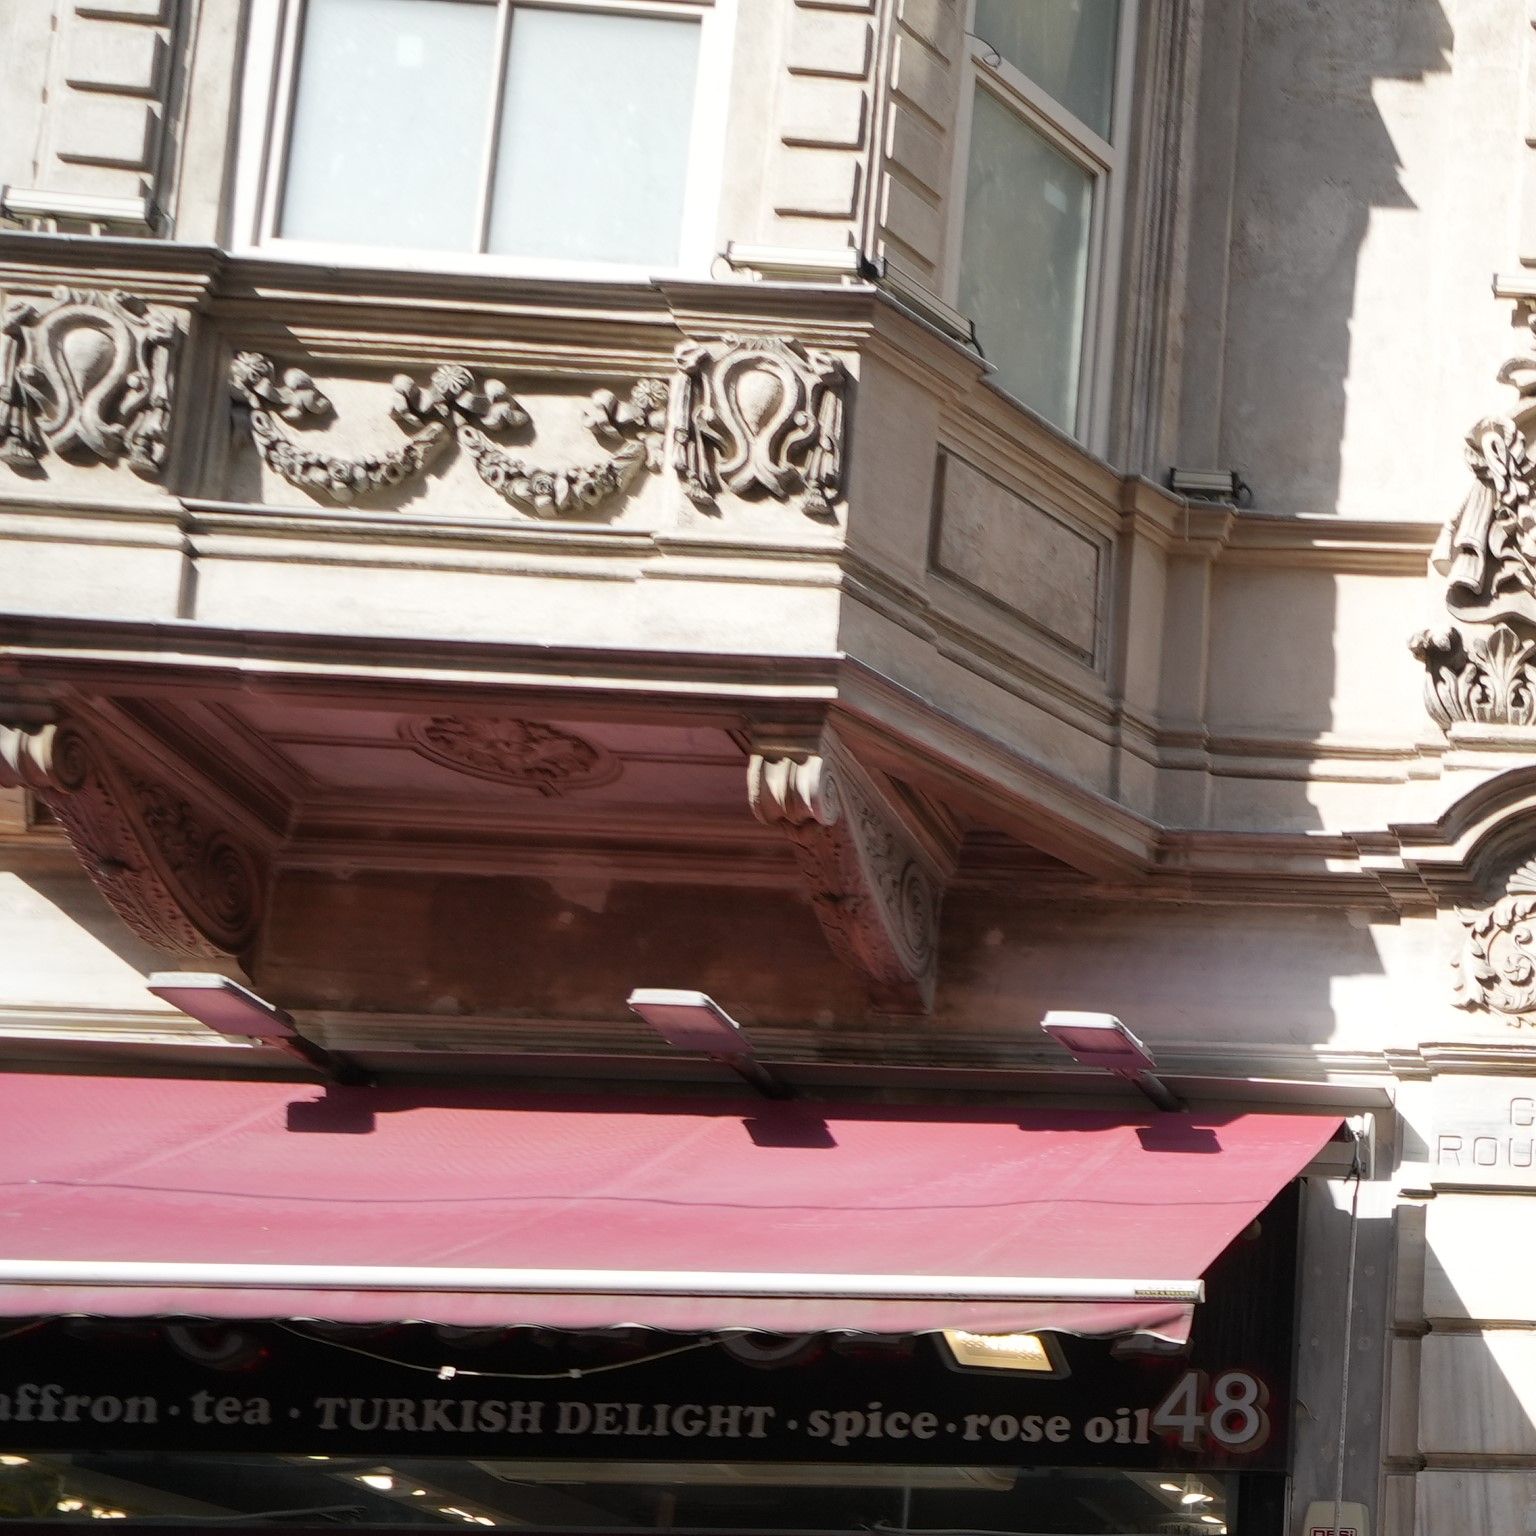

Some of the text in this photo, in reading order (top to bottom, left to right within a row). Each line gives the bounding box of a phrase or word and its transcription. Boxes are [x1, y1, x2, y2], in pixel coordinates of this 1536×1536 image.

[189, 1389, 273, 1425] tea
[315, 1396, 543, 1434] TURKISH
[556, 1400, 771, 1438] DELIGHT
[807, 1403, 937, 1447] spice
[963, 1412, 1070, 1442] rose
[1084, 1408, 1150, 1445] oil
[1152, 1371, 1266, 1447] 48
